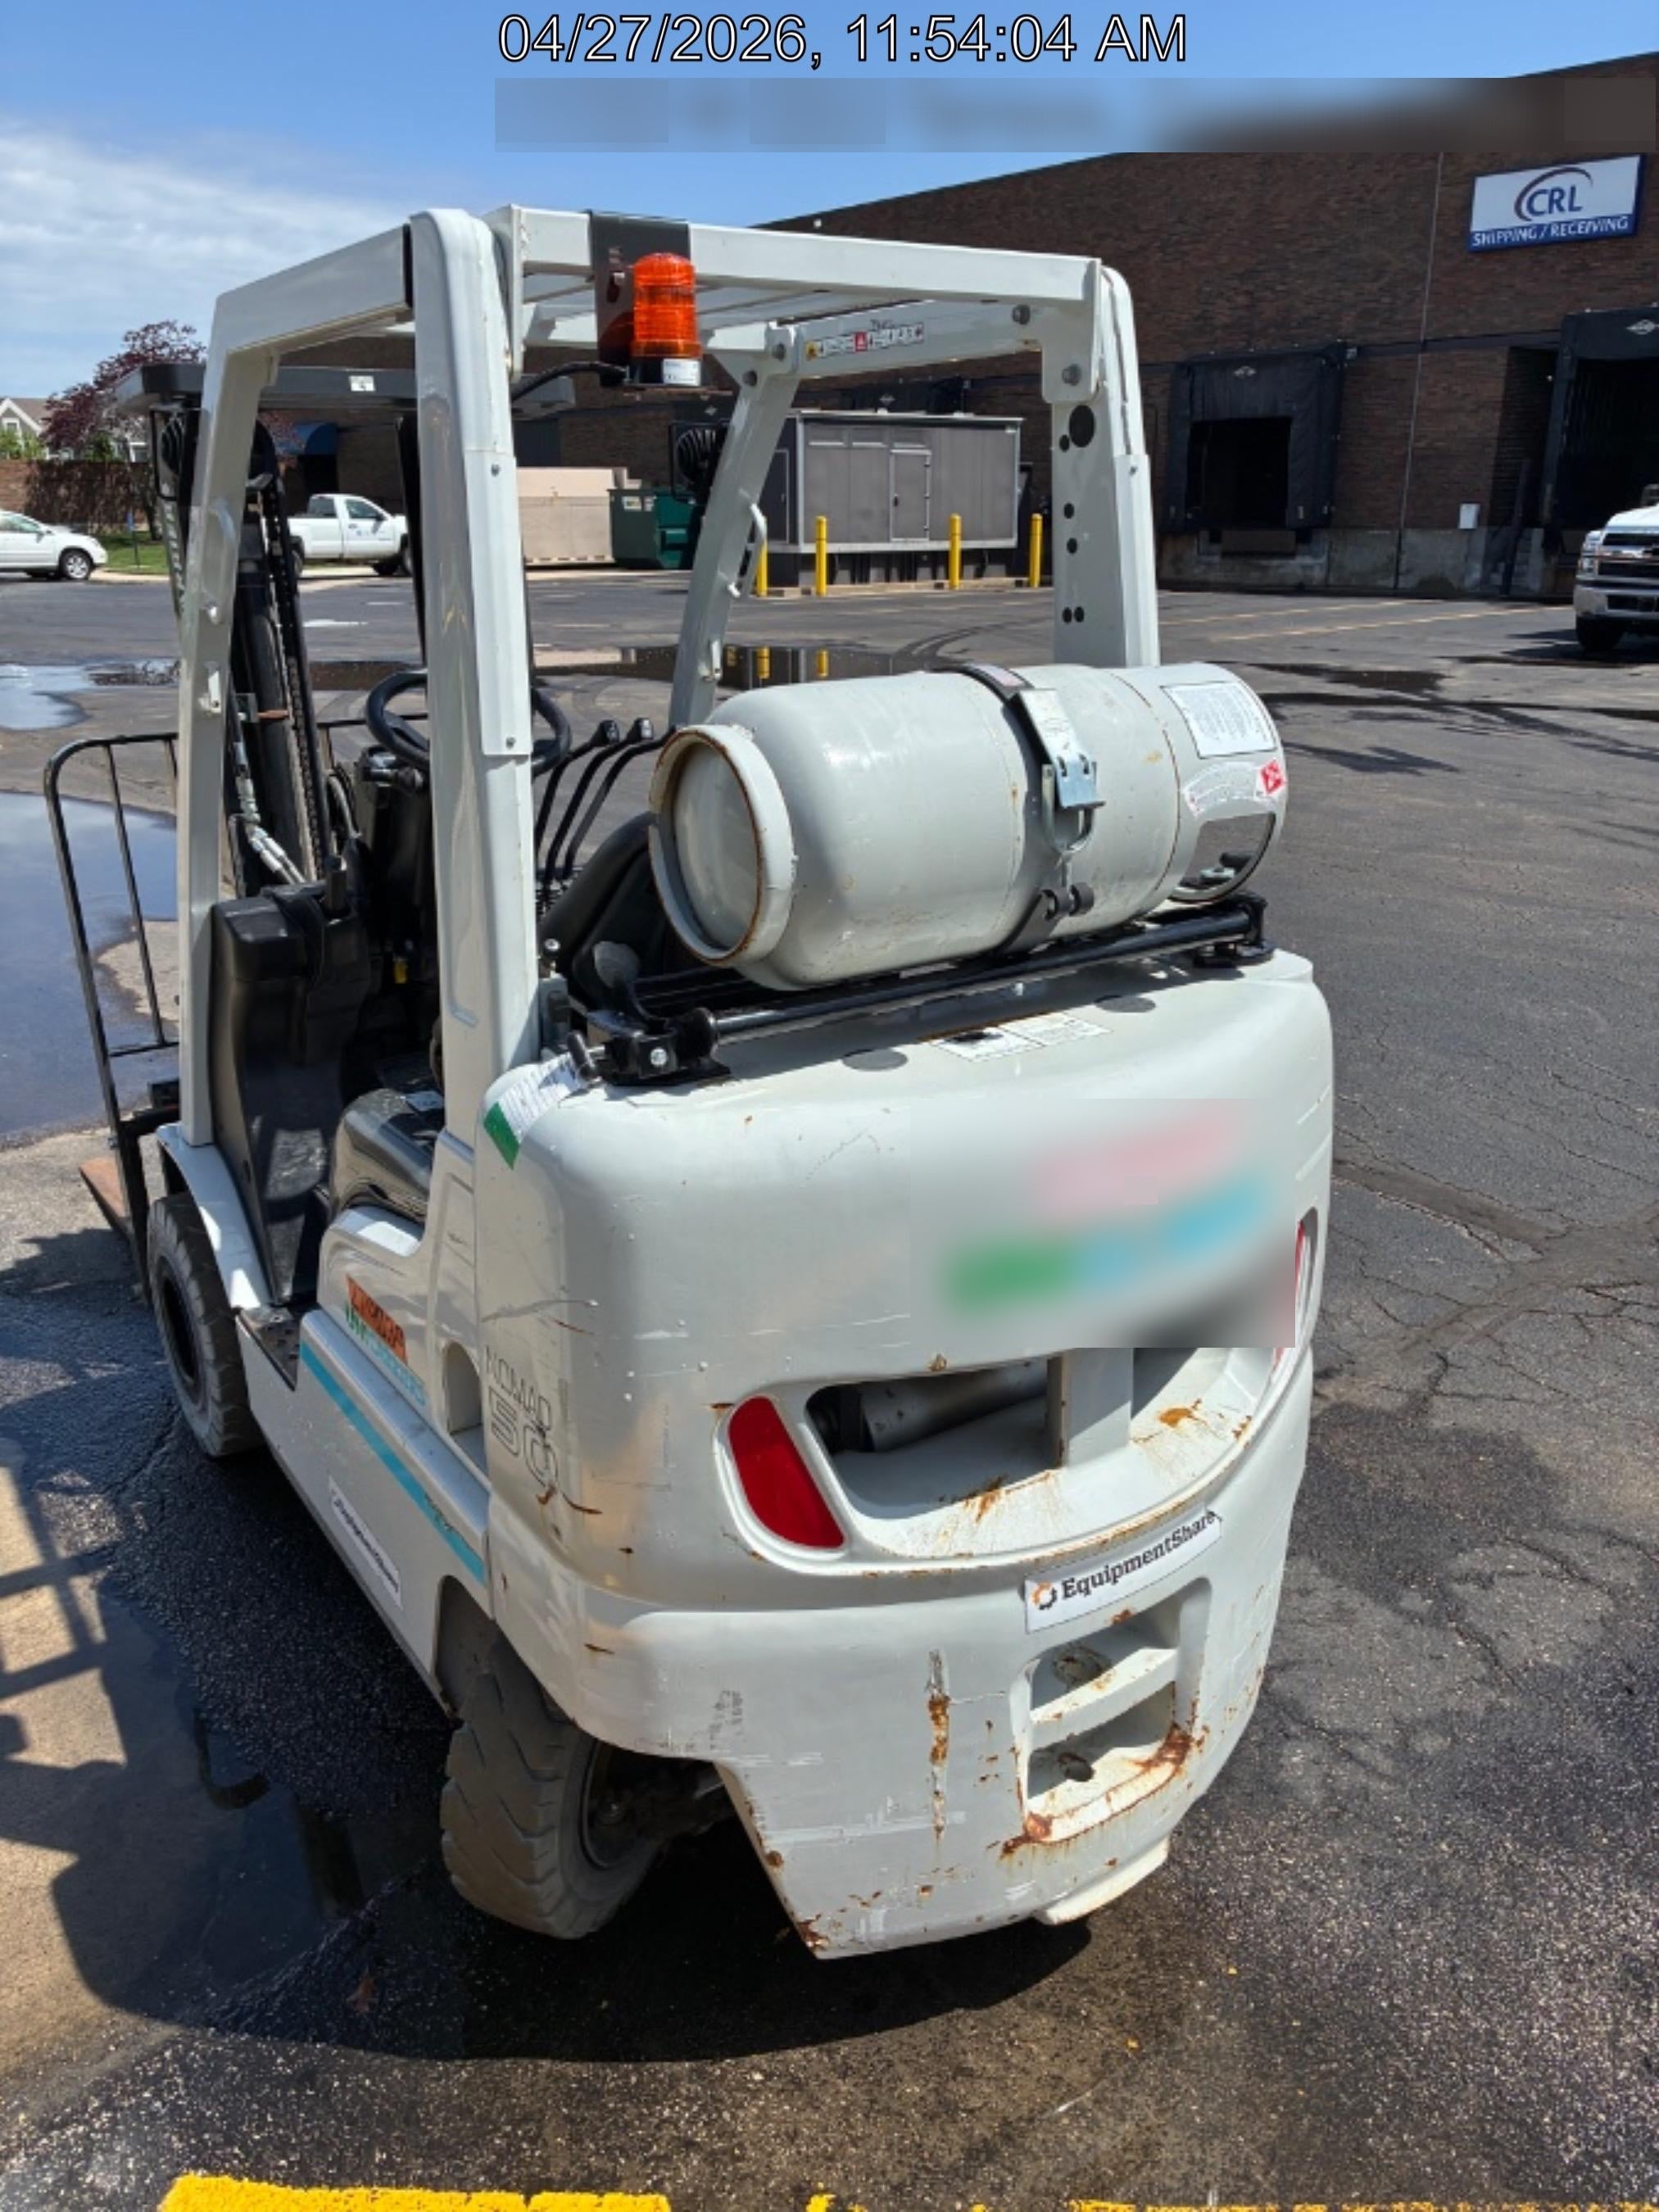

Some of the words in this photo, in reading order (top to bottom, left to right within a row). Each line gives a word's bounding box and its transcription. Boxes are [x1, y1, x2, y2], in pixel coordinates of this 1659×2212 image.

[1526, 185, 1583, 216] CRL
[1472, 226, 1537, 246] SHIPPING
[1551, 216, 1629, 238] RECEIVING
[1061, 1509, 1219, 1601] EquipmentShare
